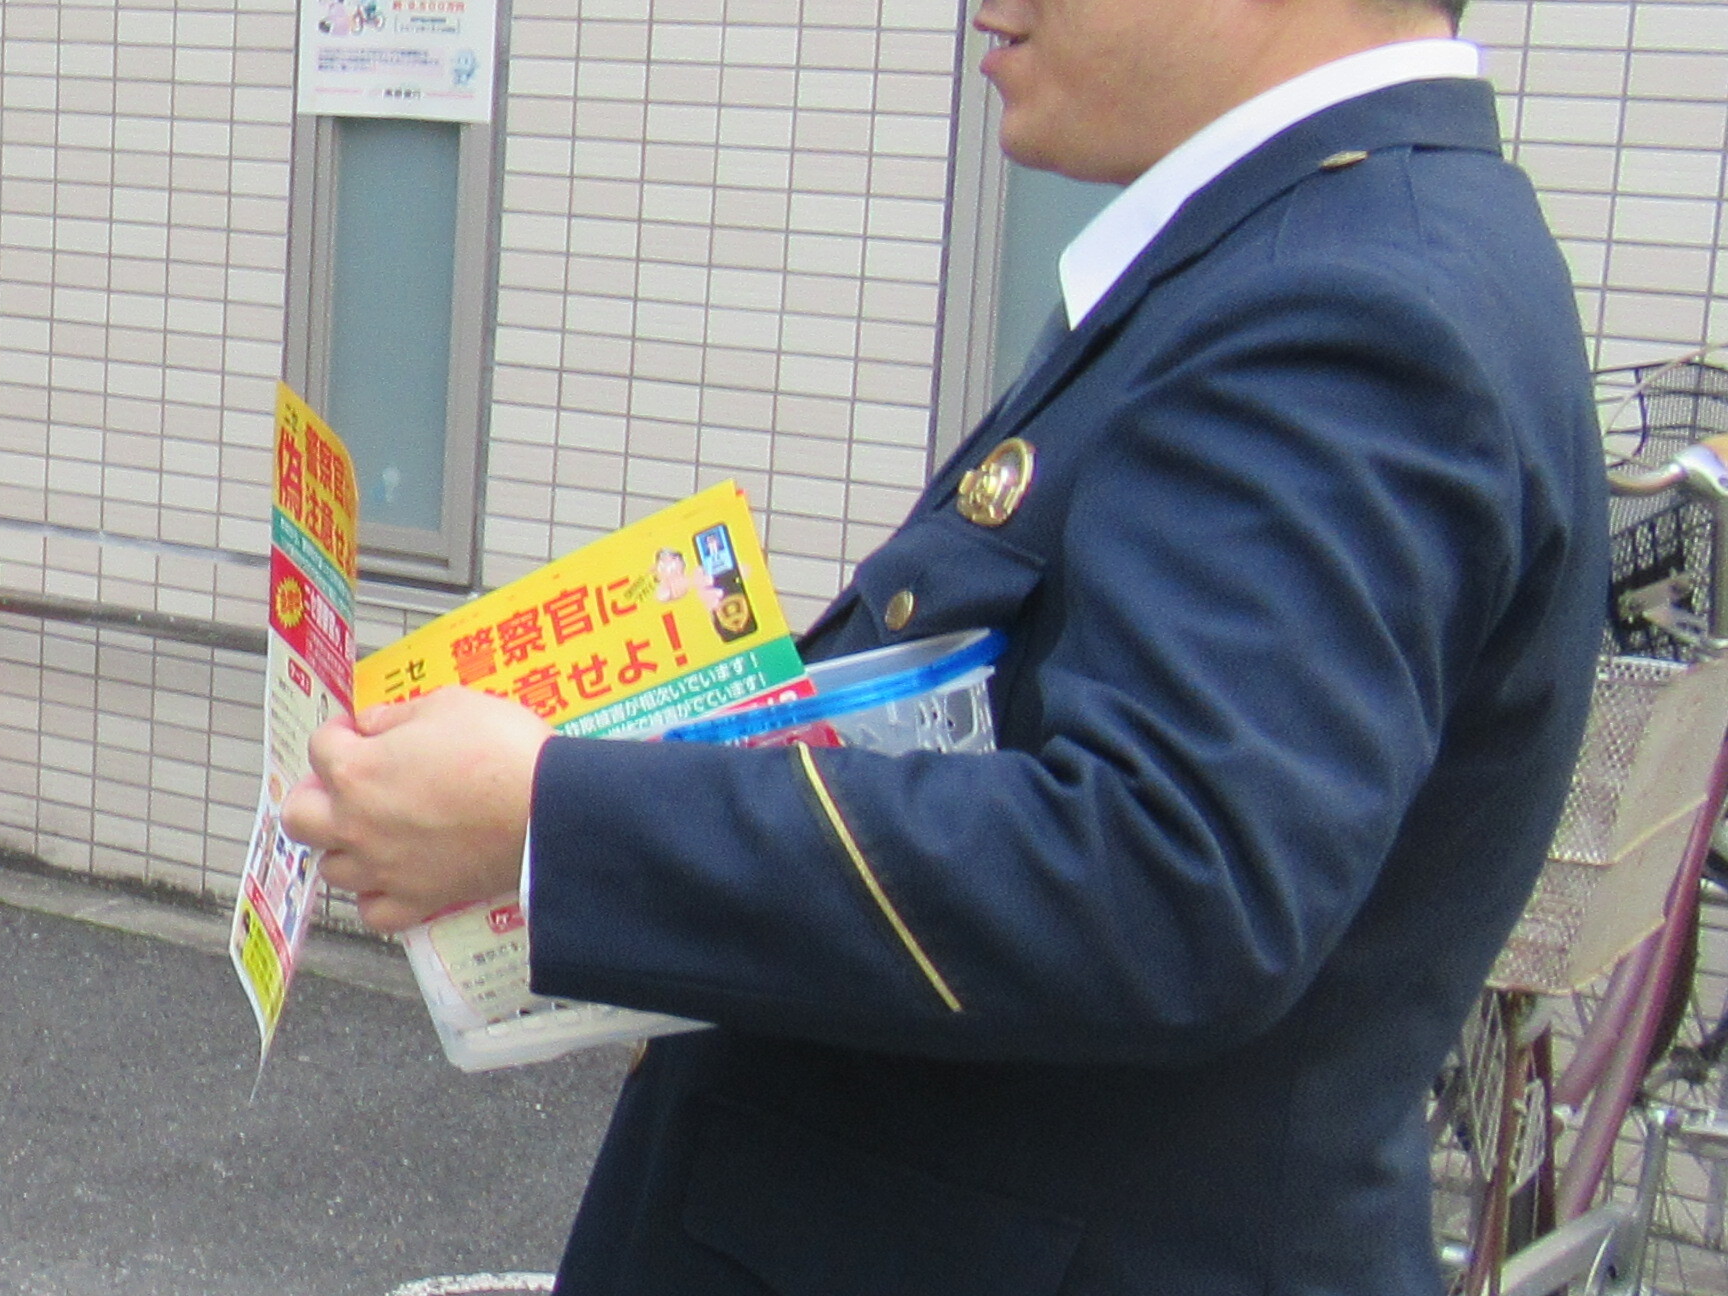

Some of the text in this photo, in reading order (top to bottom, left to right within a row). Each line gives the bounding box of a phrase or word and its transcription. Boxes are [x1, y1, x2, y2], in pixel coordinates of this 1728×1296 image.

[384, 659, 427, 694] ニセ
[450, 576, 637, 685] 警察官に
[484, 611, 689, 722] 意せよ！
